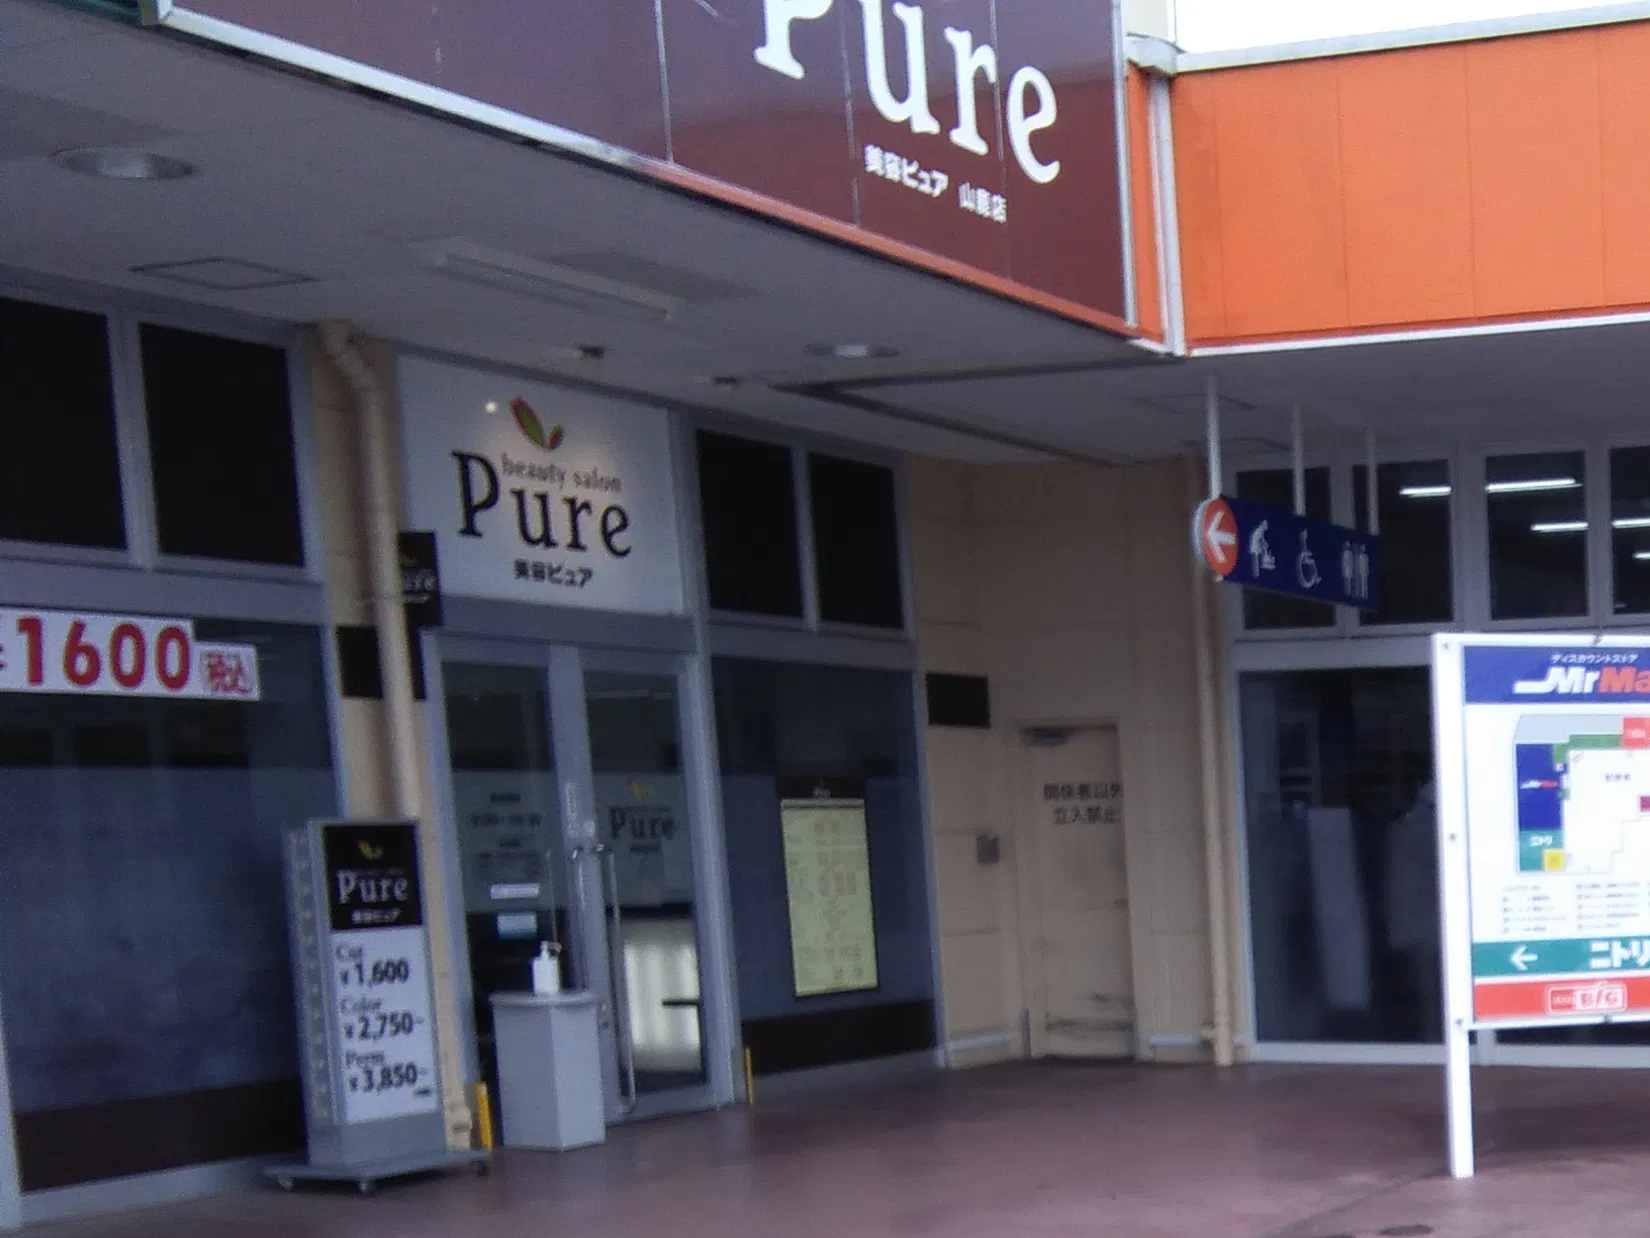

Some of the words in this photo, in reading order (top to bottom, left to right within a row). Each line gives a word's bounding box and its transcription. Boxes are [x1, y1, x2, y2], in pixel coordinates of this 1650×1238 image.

[501, 453, 566, 489] beauty
[572, 467, 623, 493] salon
[452, 450, 632, 558] Pure
[0, 616, 190, 690] 1600
[336, 868, 408, 904] Pure
